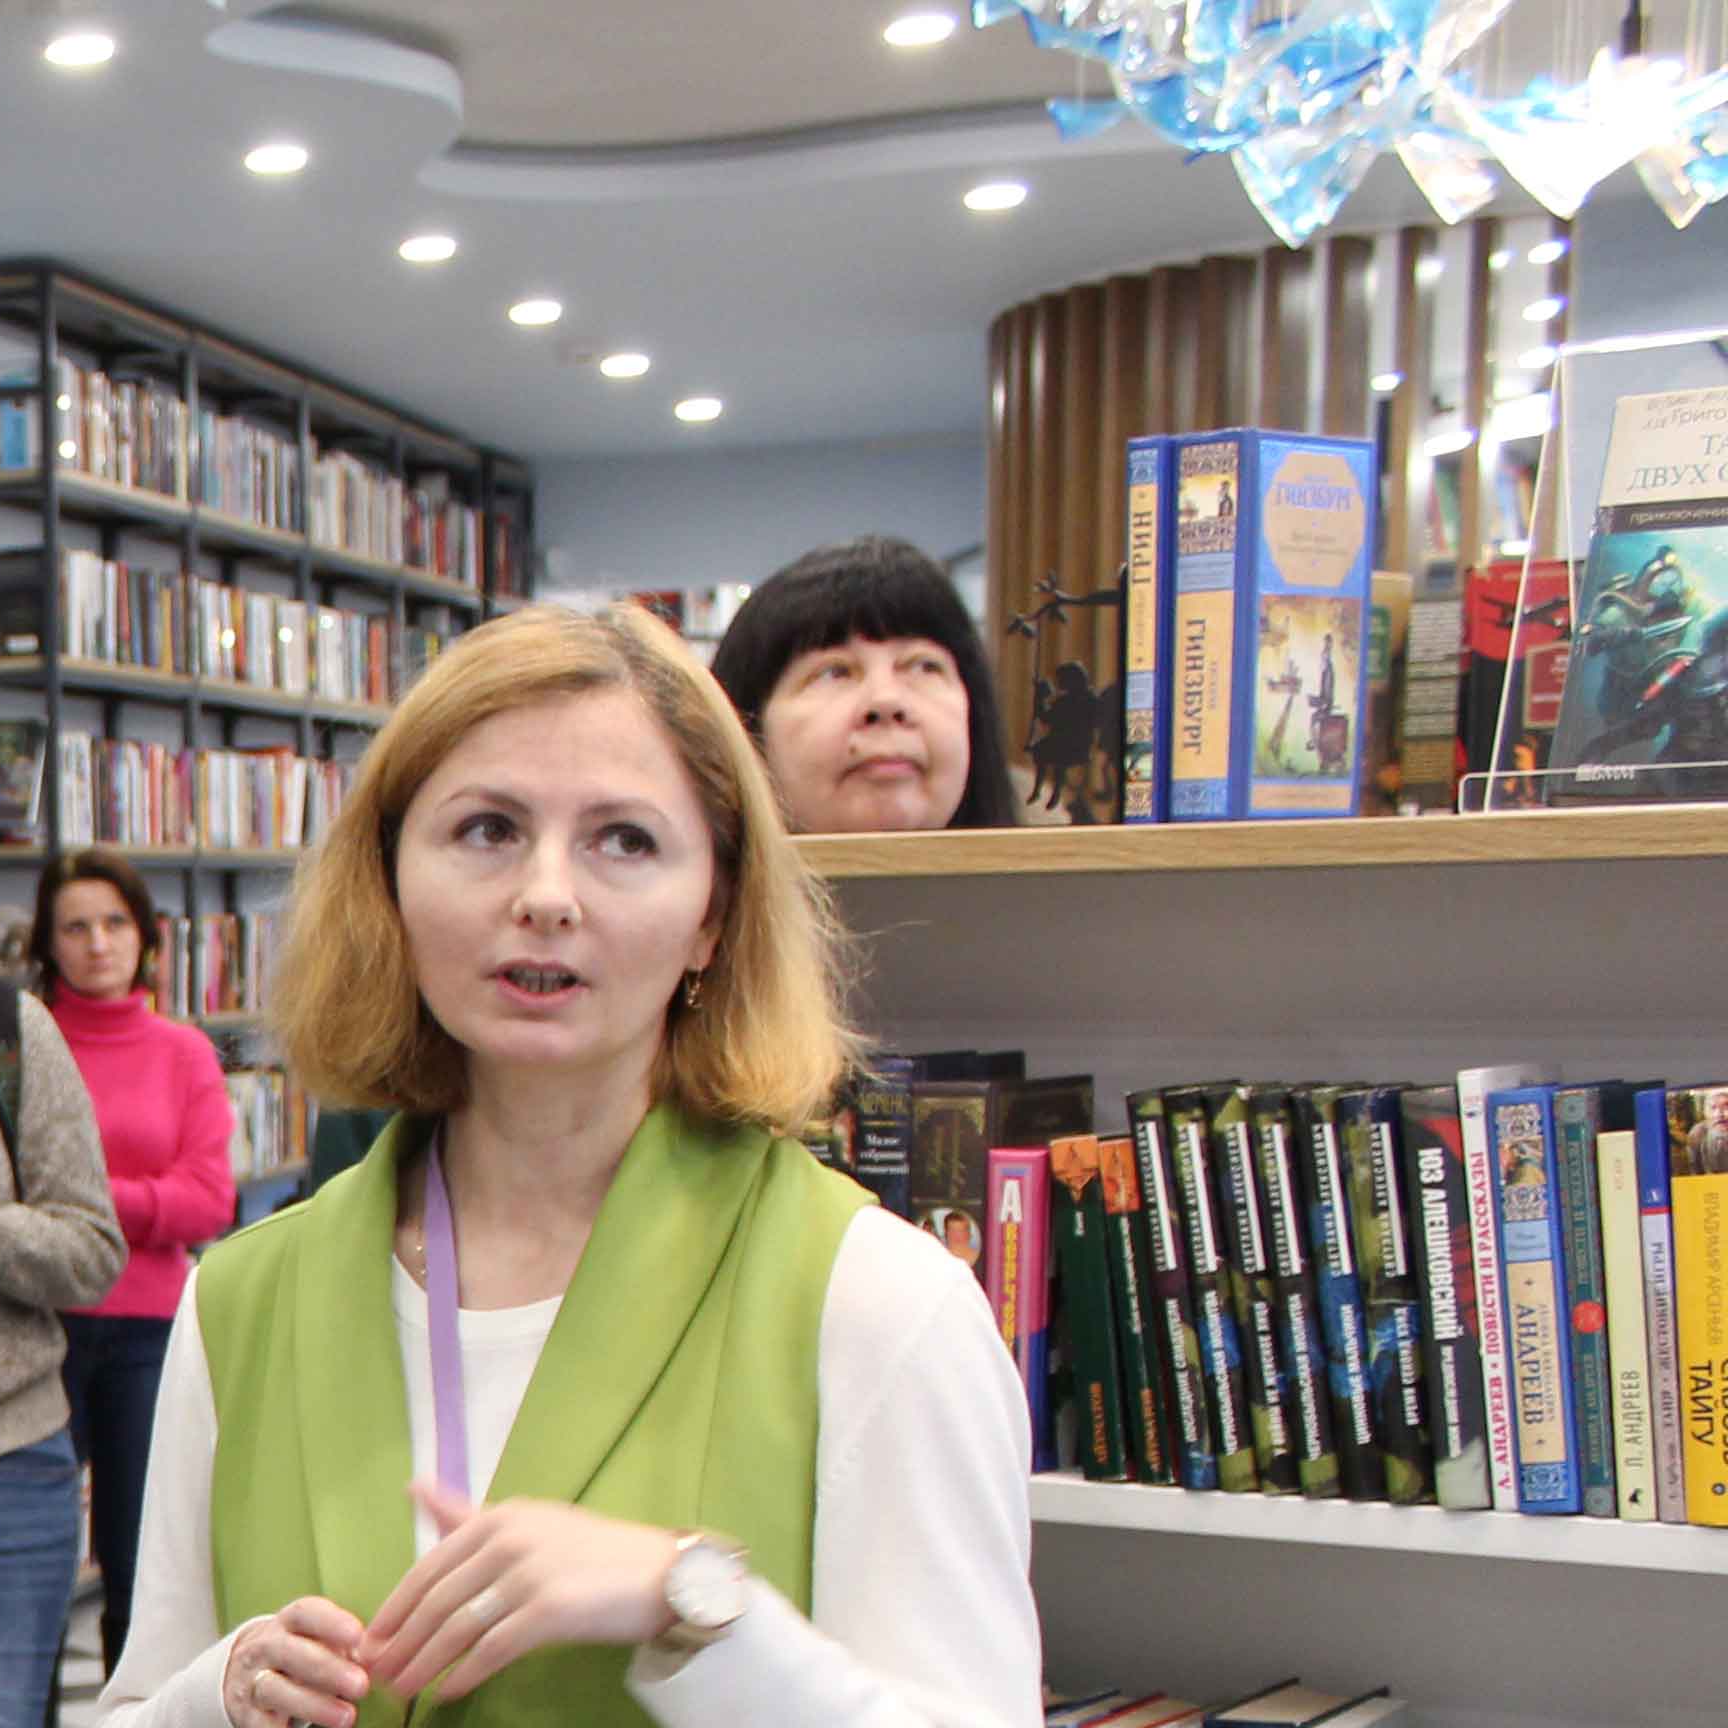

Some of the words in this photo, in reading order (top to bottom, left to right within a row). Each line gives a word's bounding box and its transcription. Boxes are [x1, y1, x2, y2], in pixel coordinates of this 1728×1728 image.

[1626, 463, 1708, 493] ДВУХ
[1132, 509, 1152, 585] ГРИН
[1183, 618, 1206, 756] ГИНЗБУРГ
[1418, 1147, 1443, 1183] ЮЗ
[1470, 1151, 1490, 1250] РАССКАЗЫ
[1423, 1189, 1463, 1340] АЛЕШКОВСКИЙ
[1480, 1277, 1500, 1355] ПОВЕСТИ
[1516, 1303, 1544, 1424] АНДРЕЕВ
[1689, 1360, 1720, 1447] ТАЙГУ
[1489, 1376, 1509, 1465] АНДРЕЕВ
[1620, 1370, 1643, 1446] АНДРЕЕВ
